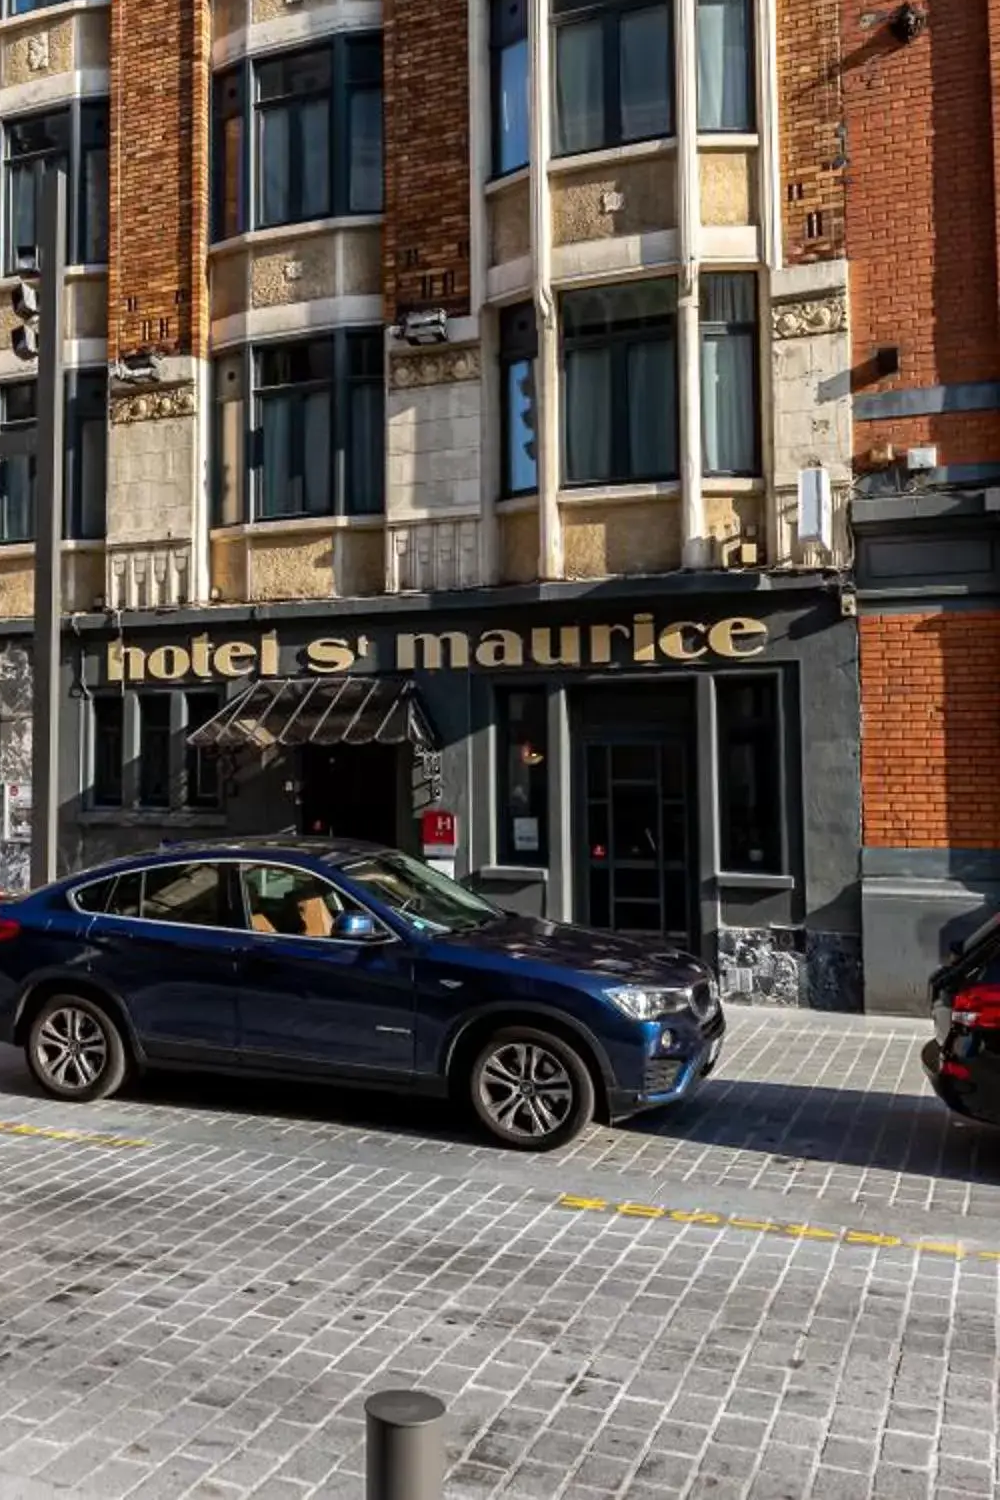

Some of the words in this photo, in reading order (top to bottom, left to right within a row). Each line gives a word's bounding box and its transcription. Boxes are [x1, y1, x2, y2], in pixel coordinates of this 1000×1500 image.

[107, 629, 279, 681] hotel
[396, 612, 769, 669] maurice
[436, 816, 451, 830] H
